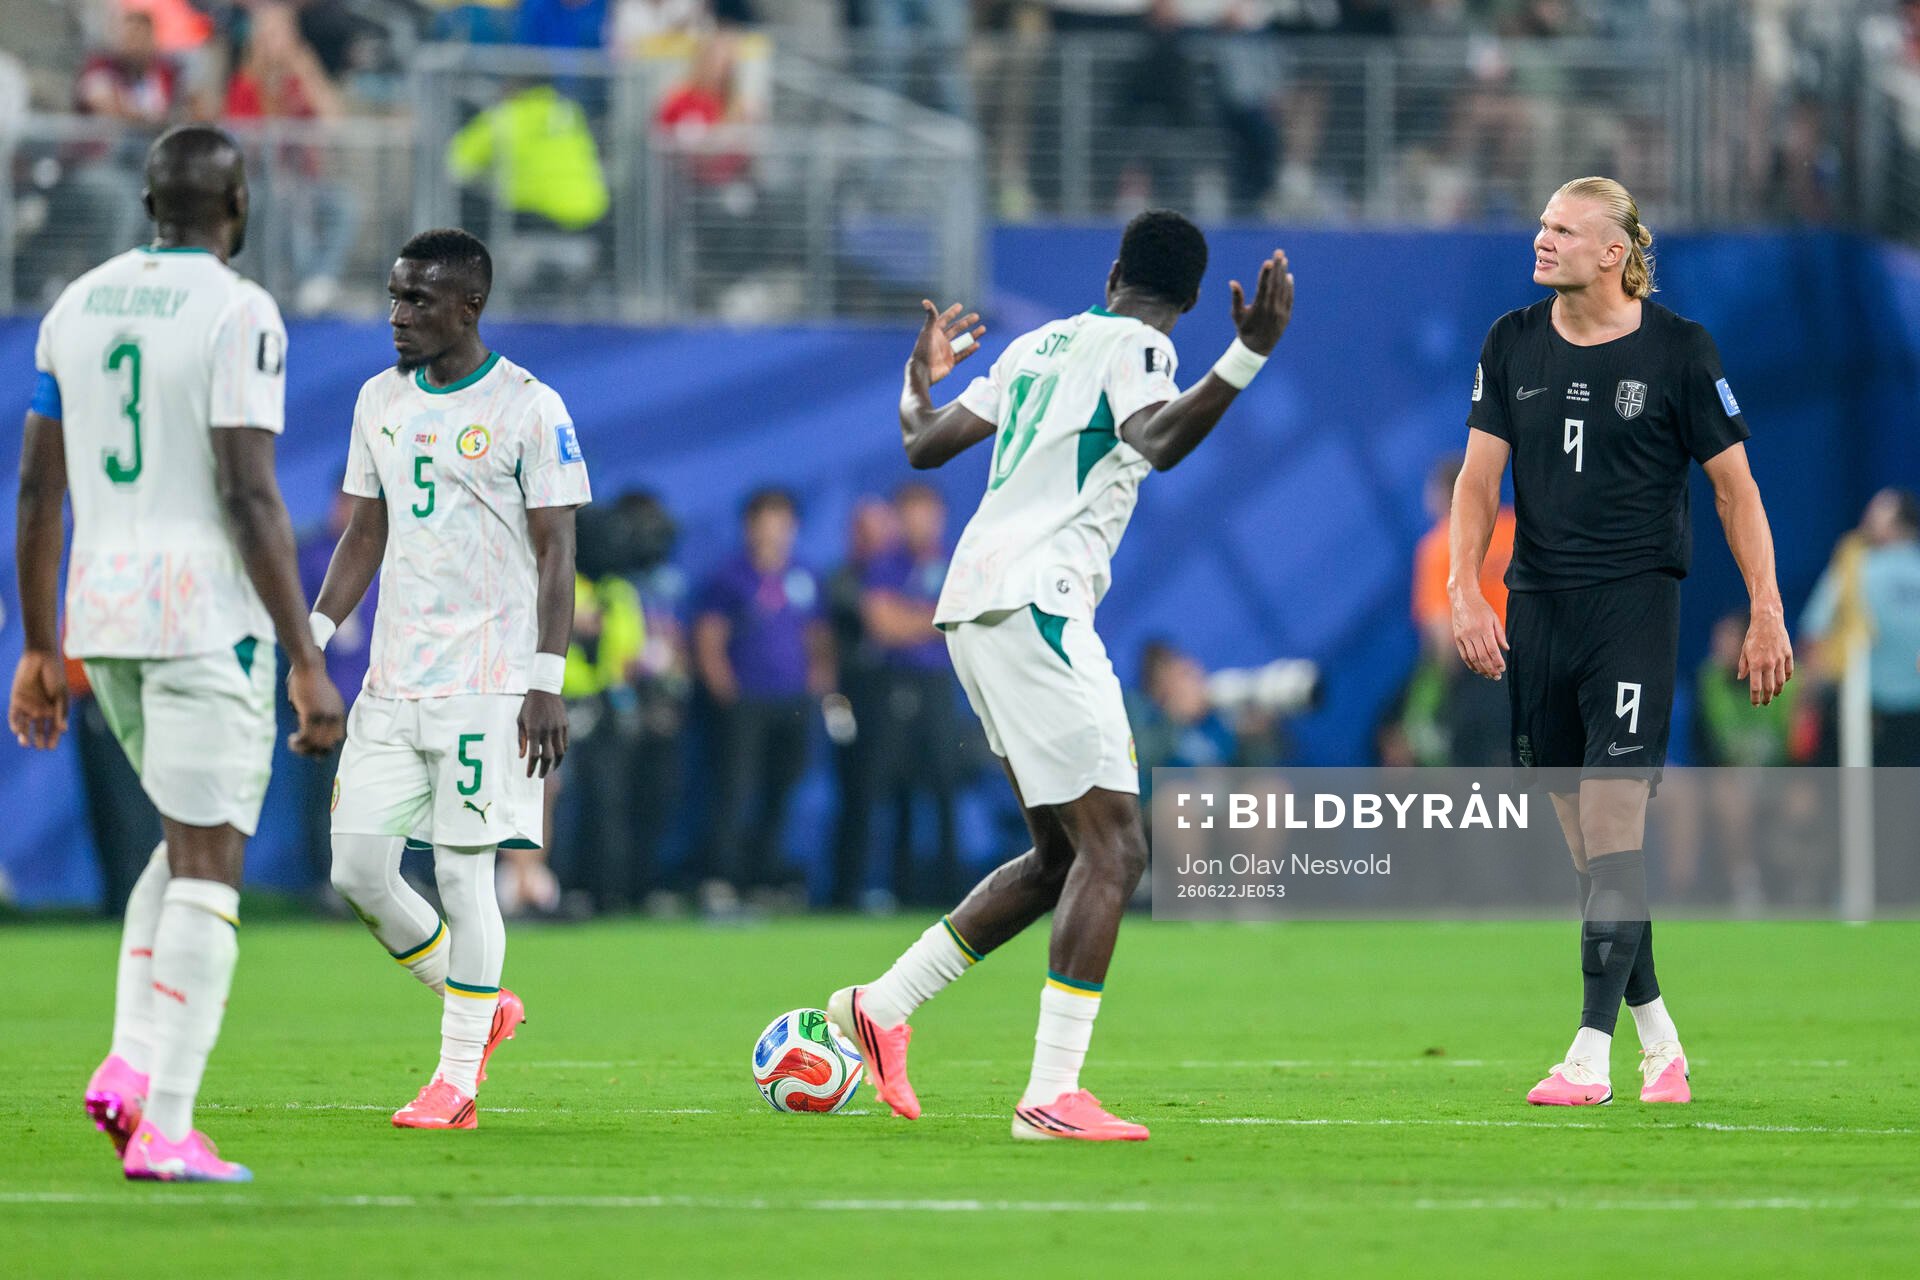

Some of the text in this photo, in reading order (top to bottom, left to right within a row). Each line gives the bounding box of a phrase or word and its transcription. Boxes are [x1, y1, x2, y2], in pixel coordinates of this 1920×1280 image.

[104, 338, 143, 485] 3
[1563, 418, 1584, 473] 9
[412, 456, 435, 518] 5
[1615, 681, 1642, 734] 9
[456, 733, 486, 796] 5
